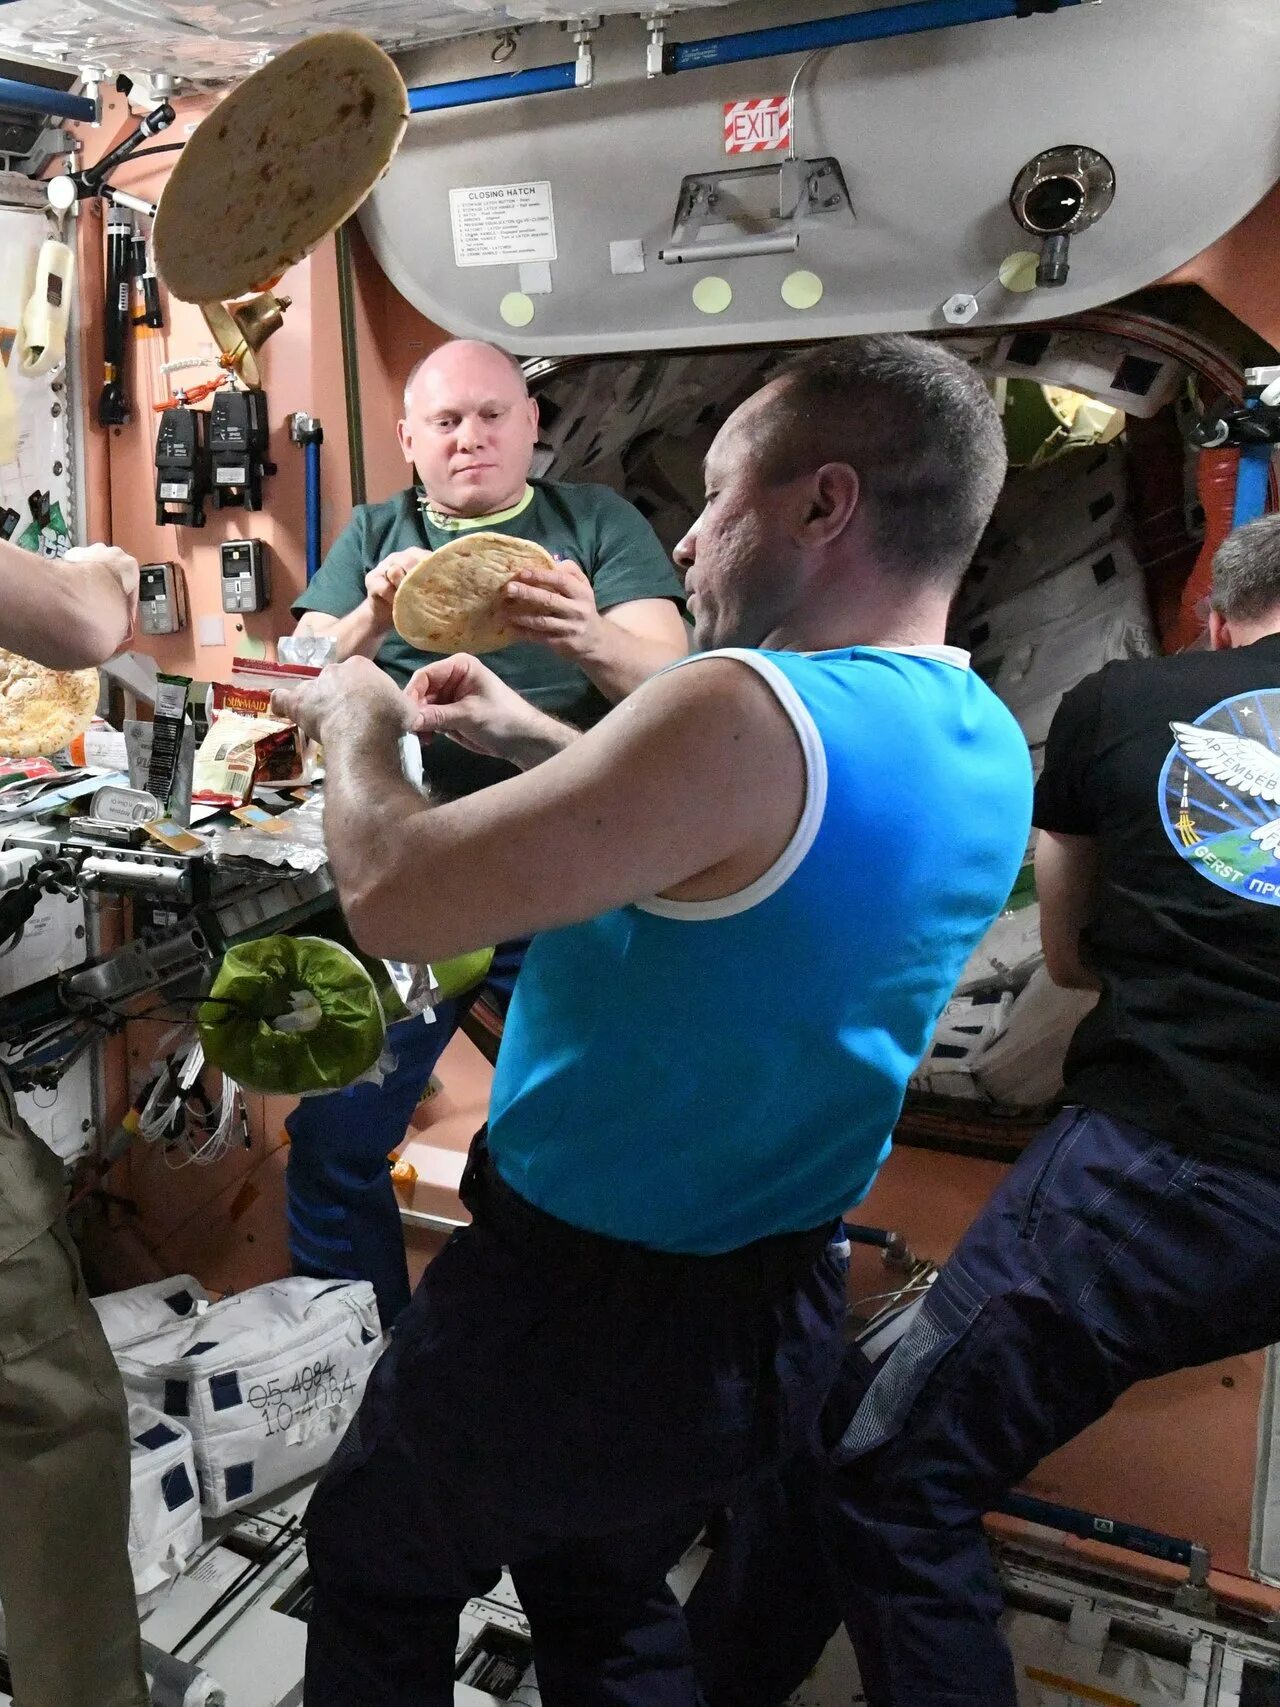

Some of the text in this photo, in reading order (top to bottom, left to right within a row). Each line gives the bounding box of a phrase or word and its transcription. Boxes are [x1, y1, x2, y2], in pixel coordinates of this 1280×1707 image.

[734, 110, 779, 141] EXIT
[468, 187, 536, 200] CLOSING HATCH
[1203, 735, 1277, 791] АРТЕМЬЕВ
[1194, 845, 1244, 882] GERST
